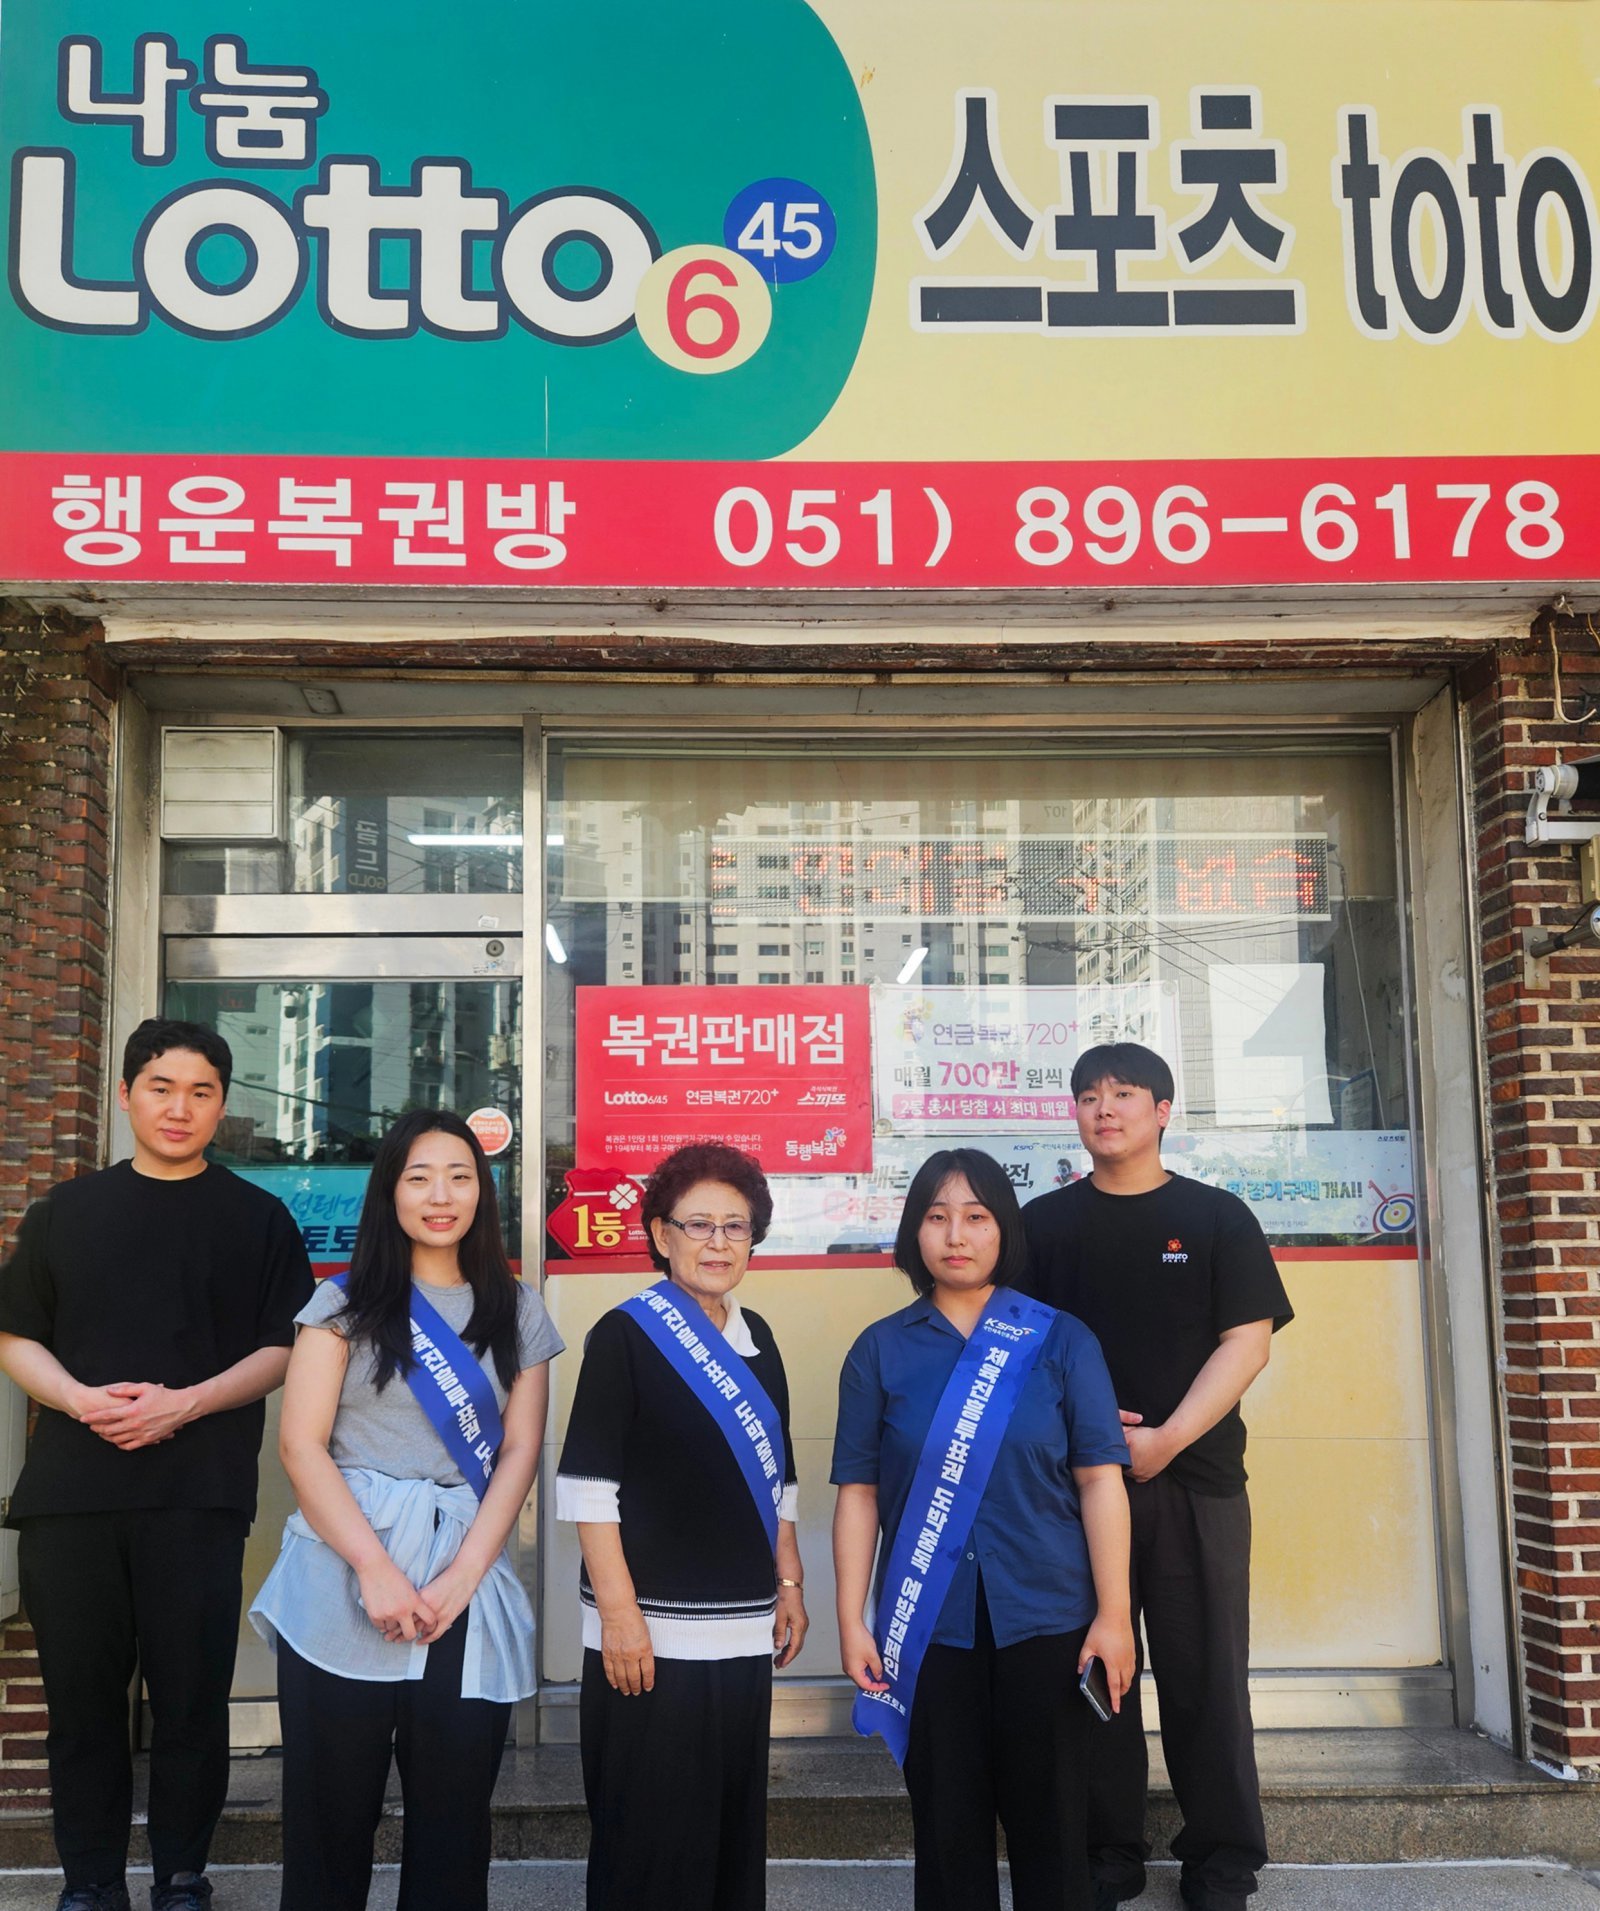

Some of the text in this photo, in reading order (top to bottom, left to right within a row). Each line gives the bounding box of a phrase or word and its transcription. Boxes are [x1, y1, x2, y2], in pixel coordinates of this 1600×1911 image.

[60, 34, 327, 167] 나눔
[13, 148, 660, 345] Lotto
[736, 201, 824, 260] 45
[918, 93, 1594, 335] 스포츠 toto
[666, 258, 741, 360] 6
[50, 473, 1566, 571] 행운복권방 051) 896-6178
[602, 1013, 845, 1067] 복권판매점
[937, 1059, 1021, 1090] 700만
[785, 1140, 838, 1161] 동행복권
[572, 1204, 626, 1247] 1등
[984, 1317, 1024, 1336] KSPO
[940, 1346, 1010, 1485] 체육진흥투표권
[910, 1486, 955, 1575] 도박중독
